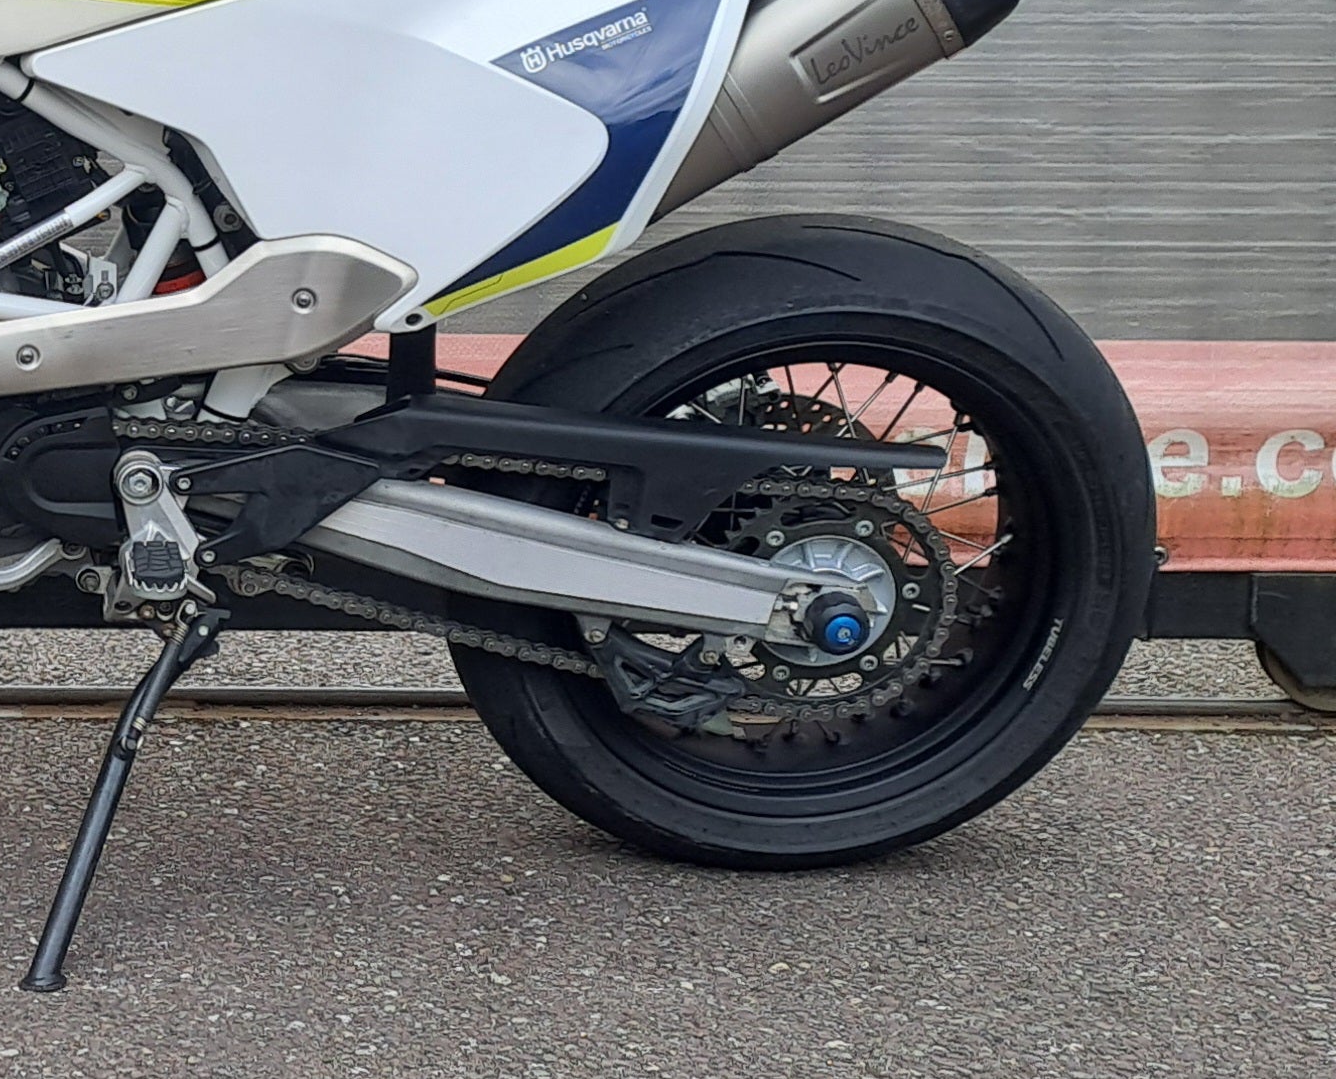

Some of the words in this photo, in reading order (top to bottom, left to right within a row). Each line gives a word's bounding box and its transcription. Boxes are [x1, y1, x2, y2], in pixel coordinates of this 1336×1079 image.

[545, 11, 648, 61] Husqvarna
[810, 17, 919, 84] LeoVince
[1023, 618, 1064, 691] TUBELESS
